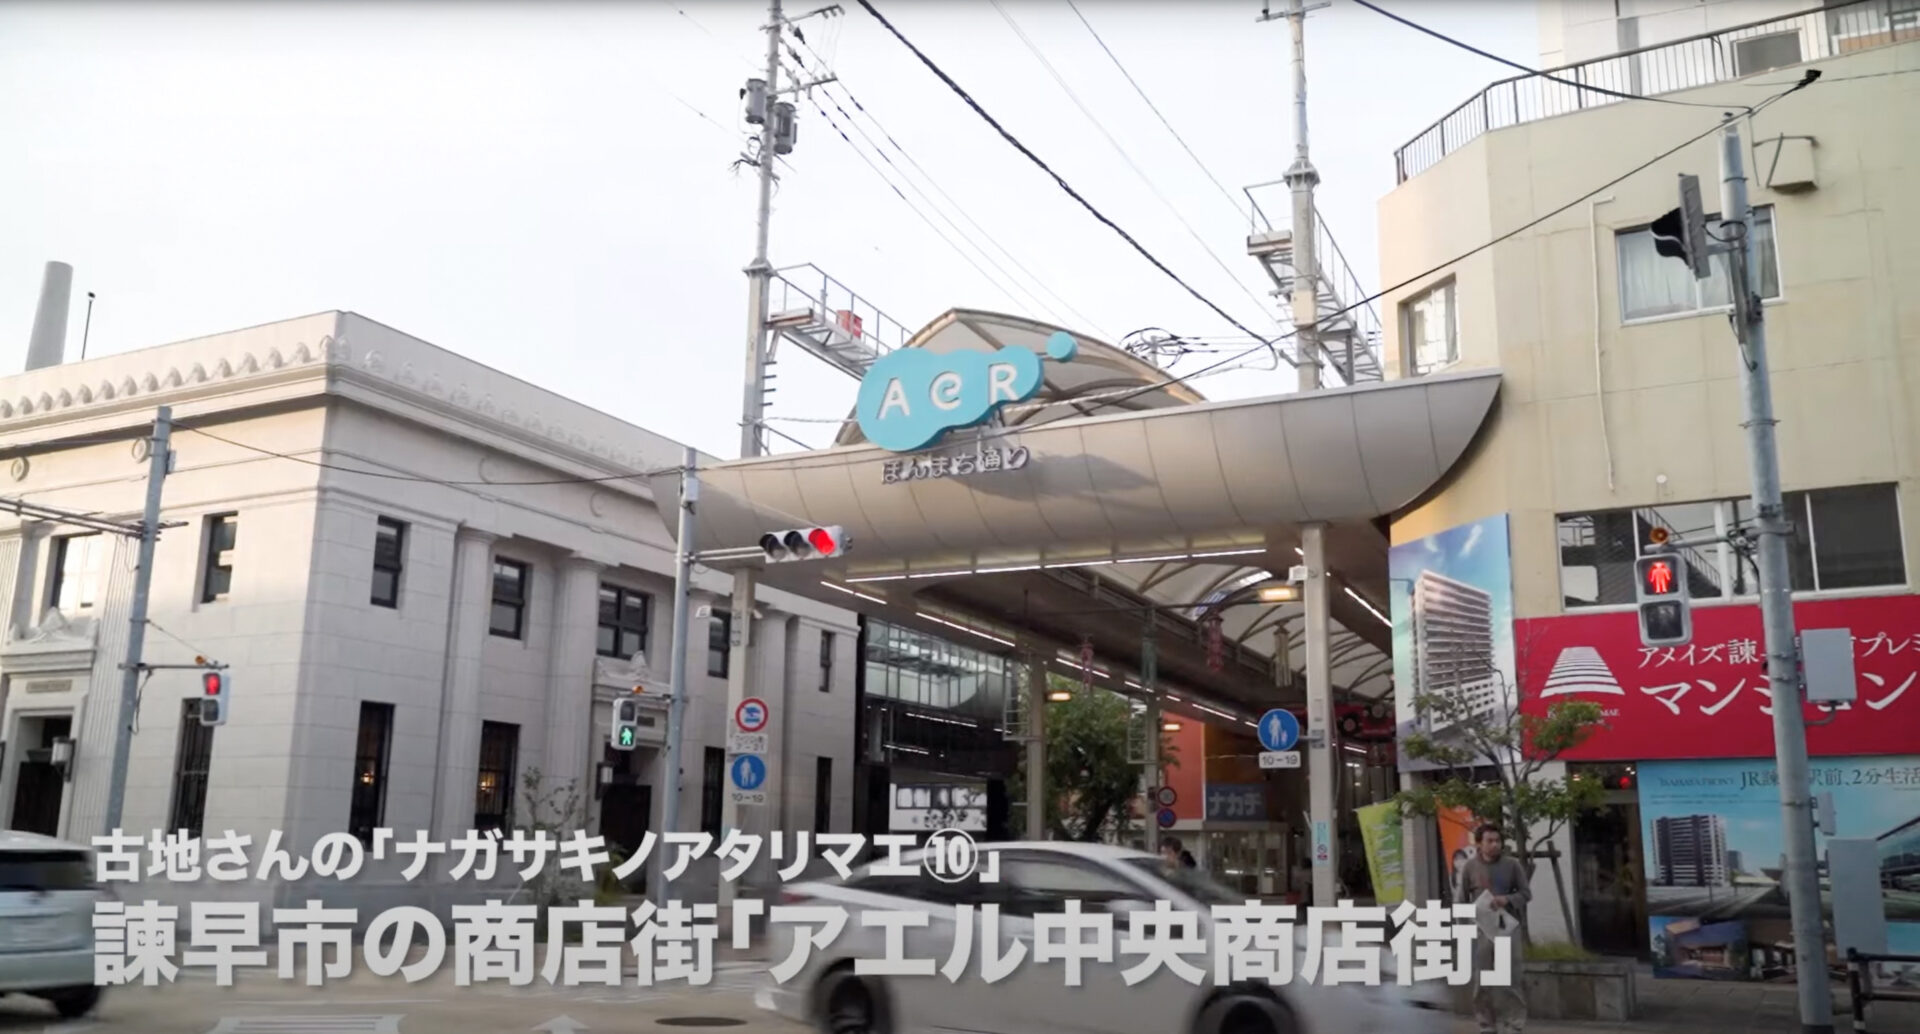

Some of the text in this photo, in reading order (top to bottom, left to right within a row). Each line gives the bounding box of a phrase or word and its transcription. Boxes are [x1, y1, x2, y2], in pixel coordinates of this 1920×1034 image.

[881, 447, 1029, 484] ほんまち通り
[1262, 755, 1298, 766] 10-19
